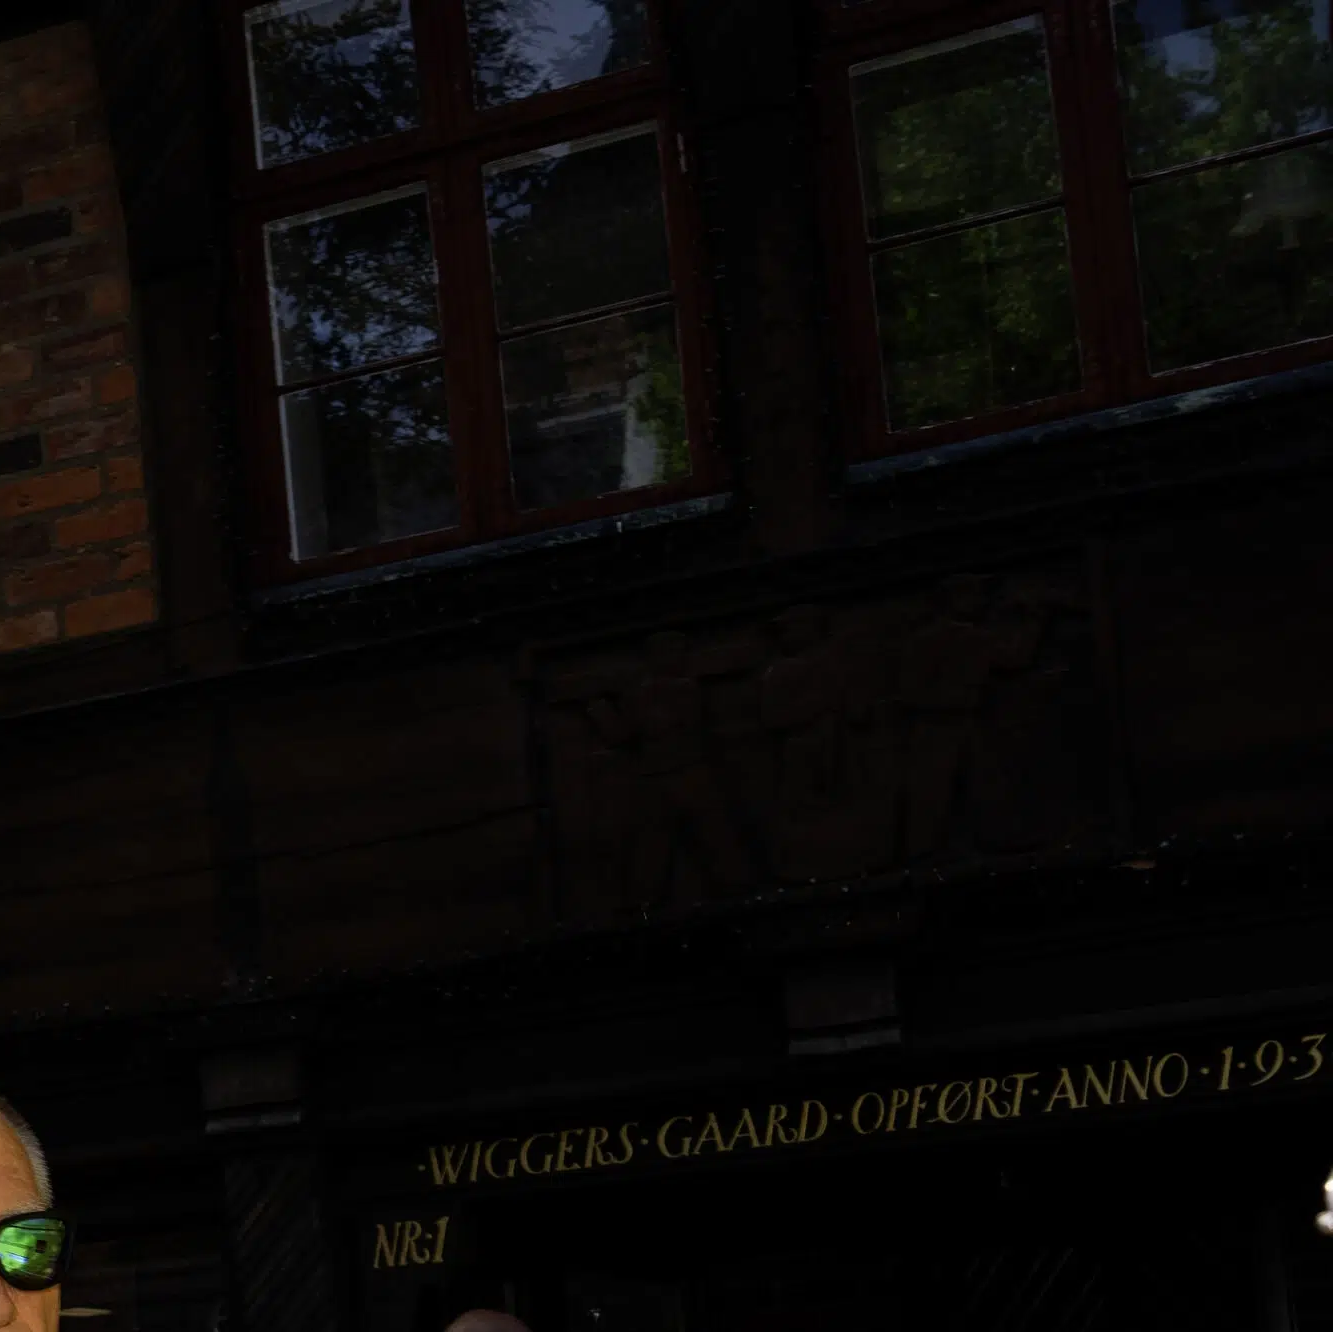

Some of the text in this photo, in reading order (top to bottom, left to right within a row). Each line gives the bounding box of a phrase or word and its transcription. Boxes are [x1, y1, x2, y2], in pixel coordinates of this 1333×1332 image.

[428, 1120, 640, 1187] WIGGERS
[656, 1099, 829, 1161] GAARD
[851, 1070, 1039, 1137] OPFØRT
[1044, 1051, 1189, 1113] ANNO
